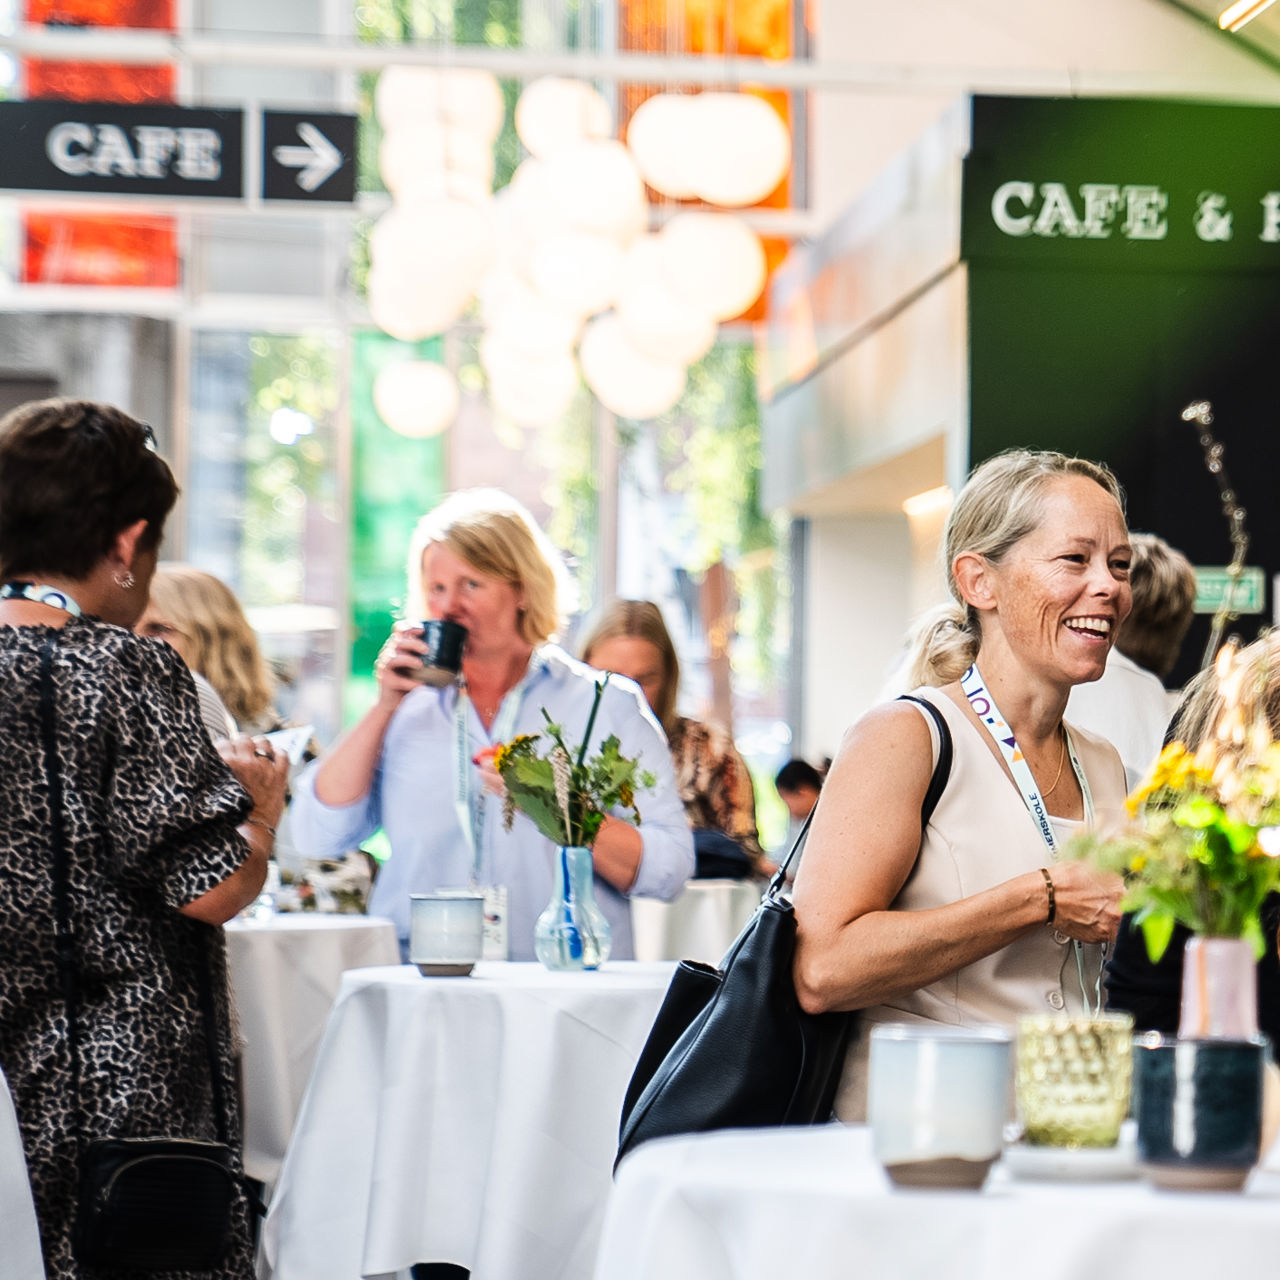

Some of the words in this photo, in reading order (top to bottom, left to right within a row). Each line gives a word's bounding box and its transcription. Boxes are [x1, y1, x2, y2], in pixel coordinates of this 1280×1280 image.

[46, 121, 222, 181] CAFE
[991, 181, 1168, 241] CAFE
[1194, 191, 1234, 242] &
